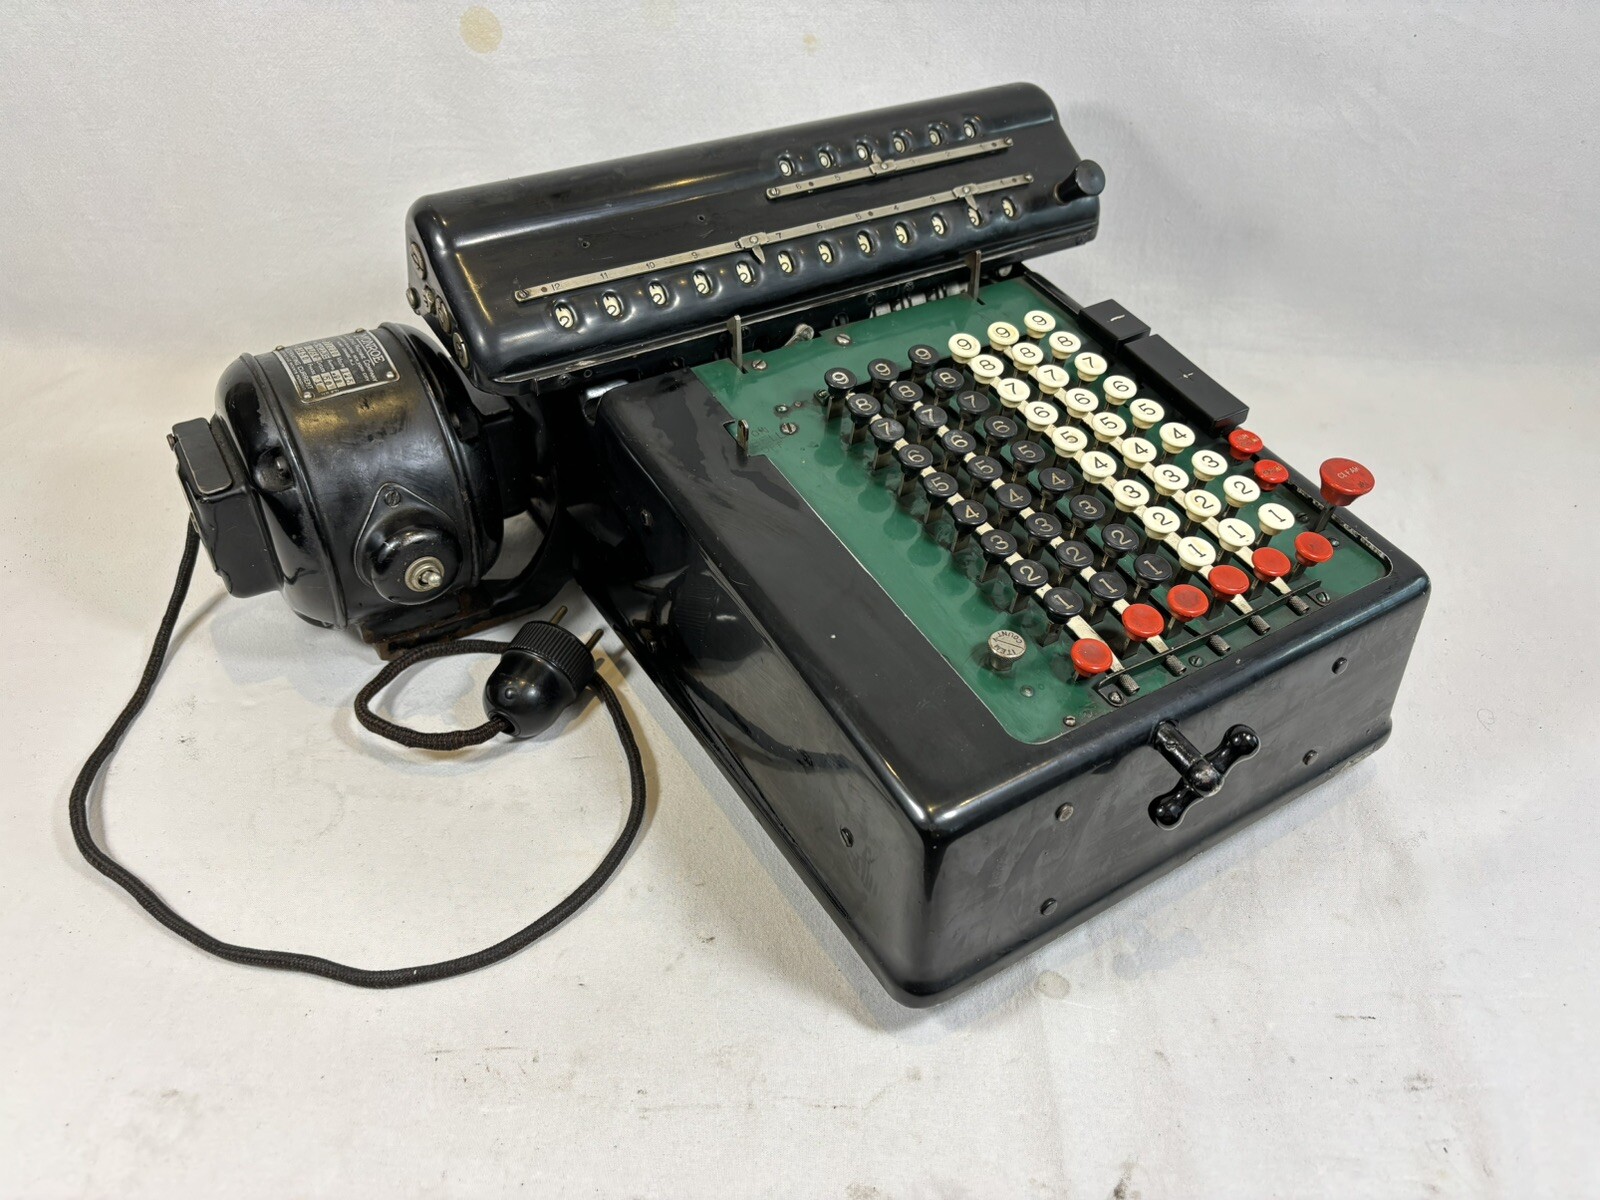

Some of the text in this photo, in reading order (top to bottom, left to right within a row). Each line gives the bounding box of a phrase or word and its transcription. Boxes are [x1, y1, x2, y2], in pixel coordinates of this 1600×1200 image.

[551, 282, 561, 291] 12
[646, 261, 656, 269] 10
[1032, 315, 1047, 326] 9
[995, 327, 1011, 338] 9
[956, 338, 972, 350] 9
[1057, 336, 1074, 347] 8
[915, 348, 931, 360] 9
[1020, 347, 1036, 358] 8
[979, 359, 996, 370] 8
[1082, 356, 1094, 368] 7
[875, 363, 891, 376] 9
[1044, 369, 1056, 381] 7
[832, 372, 849, 384] 9
[939, 372, 956, 384] 8
[898, 385, 916, 398] 8
[1004, 382, 1016, 395] 7
[1112, 380, 1130, 392] 6
[855, 398, 872, 411] 8
[964, 394, 976, 408] 7
[1074, 393, 1091, 405] 6
[921, 408, 935, 423] 7
[1033, 406, 1050, 418] 6
[1138, 403, 1156, 415] 5
[878, 422, 891, 436] 7
[992, 420, 1010, 433] 6
[1100, 416, 1118, 429] 5
[1060, 430, 1078, 444] 5
[1173, 427, 1187, 439] 4
[950, 434, 968, 448] 6
[1018, 445, 1036, 458] 5
[1134, 442, 1148, 454] 4
[908, 450, 924, 463] 6
[1094, 456, 1108, 469] 4
[1202, 455, 1220, 468] 3
[975, 460, 994, 474] 5
[1336, 466, 1359, 479] CLEAR
[1052, 472, 1066, 485] 4
[1162, 469, 1181, 483] 3
[931, 476, 949, 492] 5
[1234, 481, 1253, 495] 2
[1009, 488, 1023, 502] 4
[1122, 485, 1142, 499] 3
[1078, 500, 1098, 516] 3
[1194, 495, 1214, 509] 2
[965, 505, 980, 518] 4
[1268, 509, 1286, 522] 1
[1034, 518, 1054, 532] 3
[1152, 512, 1173, 526] 2
[1111, 530, 1132, 545] 2
[1227, 524, 1246, 539] 1
[990, 535, 1008, 550] 3
[1066, 546, 1087, 562] 2
[1188, 543, 1206, 558] 1
[1020, 566, 1041, 582] 2
[1143, 560, 1163, 575] 1
[1098, 578, 1118, 594] 1
[1053, 594, 1074, 610] 1
[997, 631, 1023, 643] COUNT
